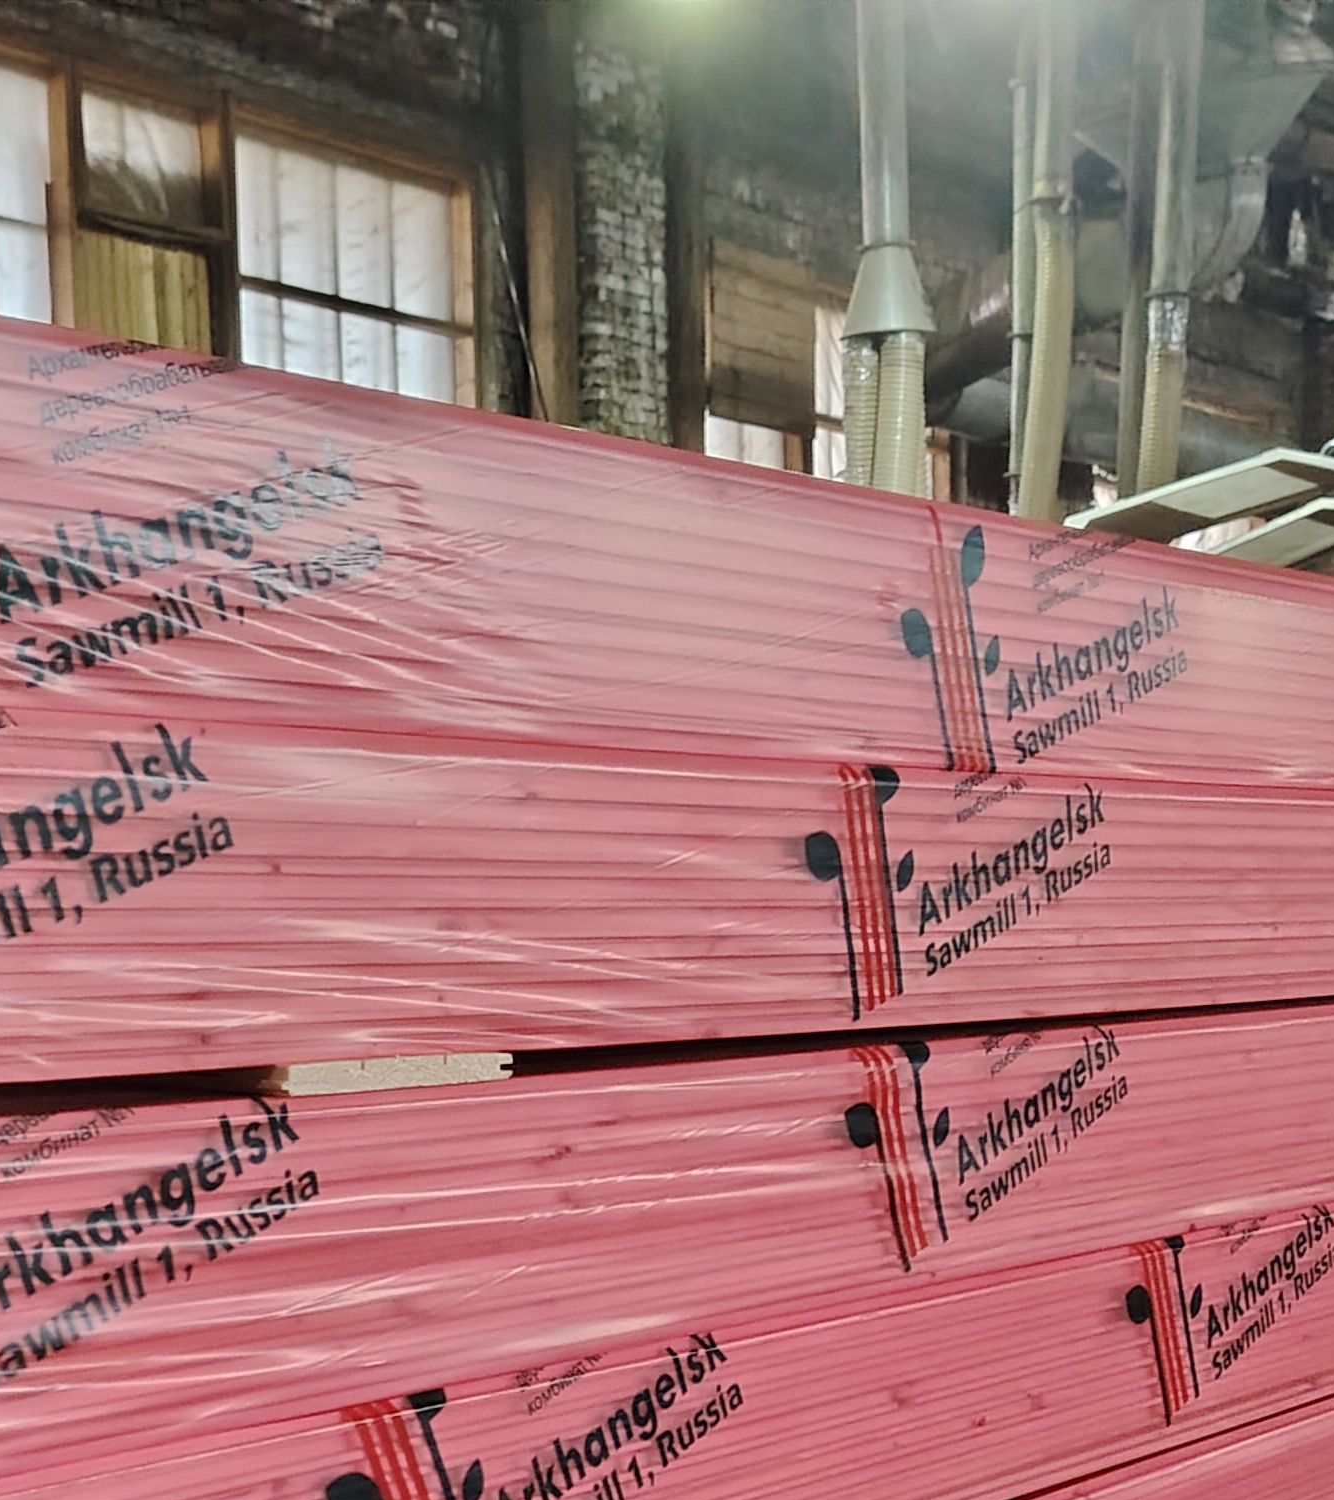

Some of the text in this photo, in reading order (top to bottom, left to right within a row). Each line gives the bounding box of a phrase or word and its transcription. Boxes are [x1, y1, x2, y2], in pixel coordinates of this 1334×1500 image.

[15, 527, 385, 689] Sawmill 1, Russia
[1007, 586, 1179, 722] Arkhangelsk
[1013, 689, 1101, 764] Sawmill
[1127, 646, 1188, 702] Russia
[41, 876, 84, 924] 1,
[91, 811, 234, 903] Russia
[919, 782, 1105, 936] Arkhangelsk
[926, 893, 1017, 977] Sawmill
[1045, 841, 1111, 903] Russia
[958, 1024, 1120, 1186] Arkhangelsk
[964, 1137, 1048, 1222] Sawmill
[1070, 1075, 1128, 1139] Russia
[196, 1168, 321, 1262] Russia
[1207, 1204, 1334, 1349] Arkhangelsk
[1212, 1300, 1275, 1380] Sawmill
[656, 1380, 745, 1467] Russia
